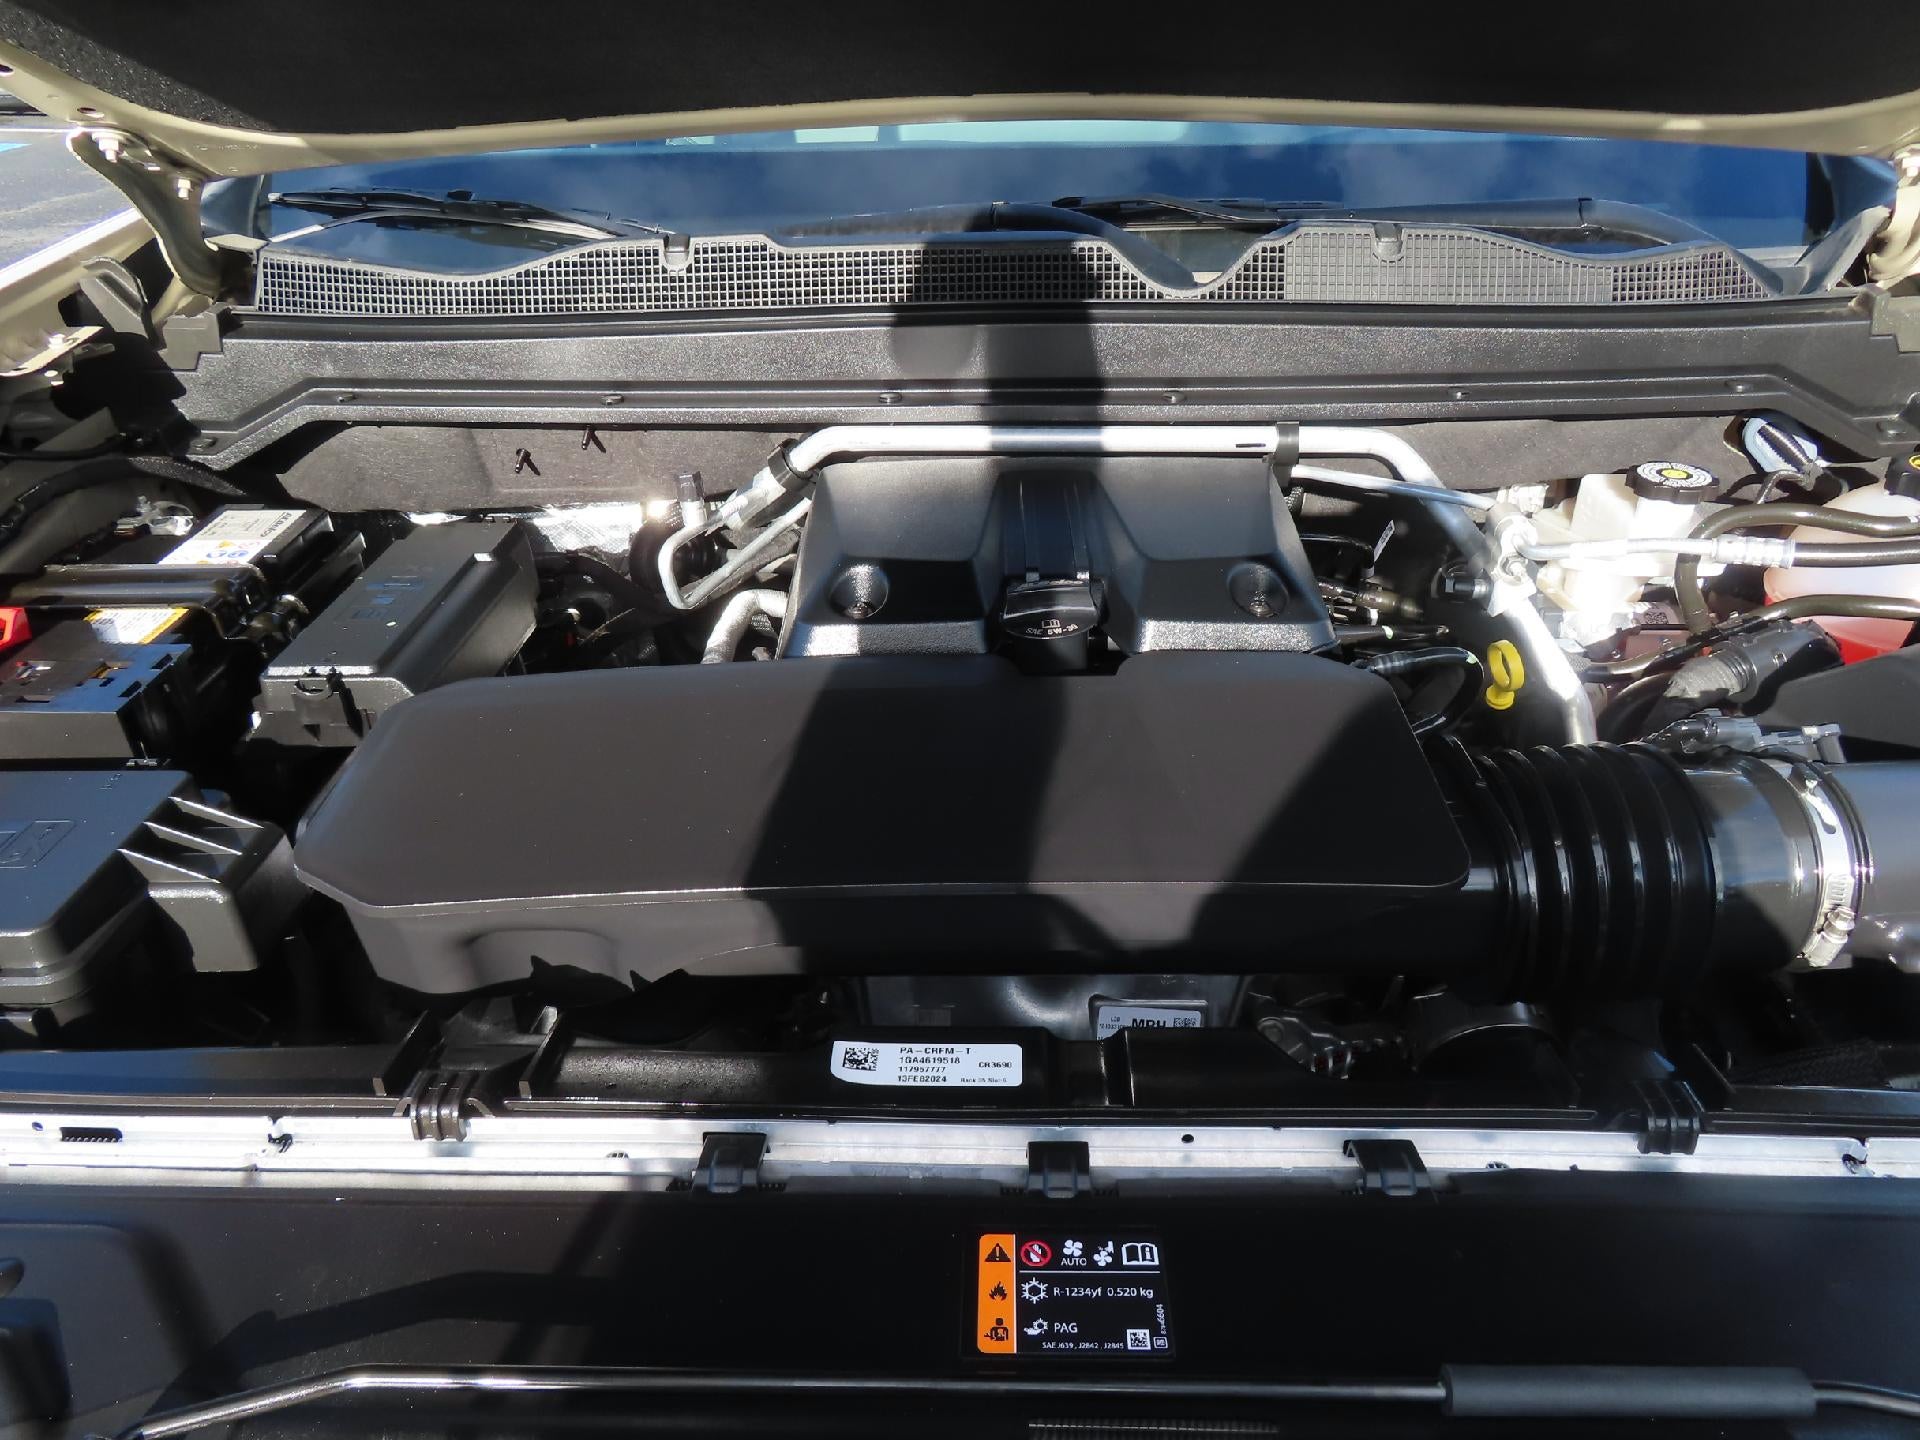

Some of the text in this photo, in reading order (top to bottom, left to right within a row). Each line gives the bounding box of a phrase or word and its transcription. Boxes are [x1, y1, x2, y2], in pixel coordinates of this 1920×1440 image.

[1047, 624, 1078, 635] 5W-30
[1061, 1258, 1087, 1266] AUTO
[1053, 1286, 1154, 1299] R-1234yf 0.520 kg
[1054, 1322, 1078, 1334] PAG
